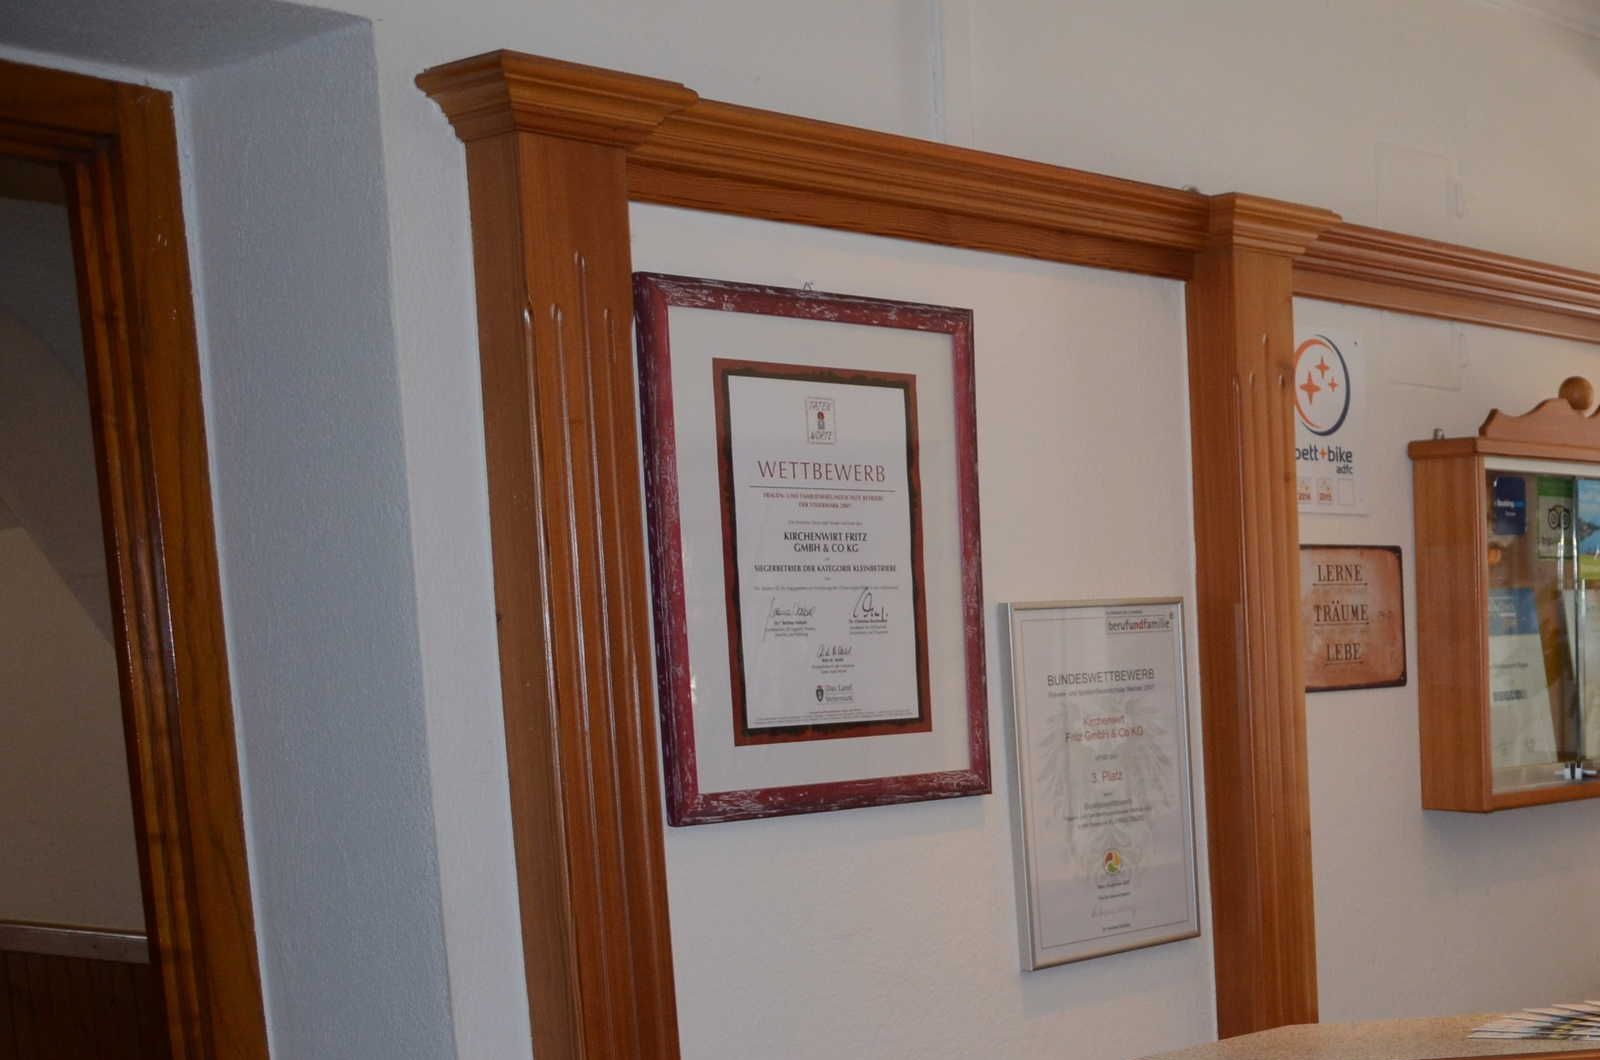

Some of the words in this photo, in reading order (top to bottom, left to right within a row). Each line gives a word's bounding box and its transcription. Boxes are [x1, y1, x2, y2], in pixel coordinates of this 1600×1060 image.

[757, 460, 886, 482] WETTBEWERB
[783, 532, 843, 542] KIRCHENWIRT
[845, 532, 868, 542] FRITZ
[793, 543, 821, 553] GMBH
[831, 544, 845, 553] CO
[846, 544, 859, 553] KG
[1317, 564, 1363, 583] LERNE
[1313, 600, 1369, 622] TRÄUME
[1327, 642, 1361, 661] LEBE
[1047, 669, 1155, 686] BUNDESWETTBEWERB
